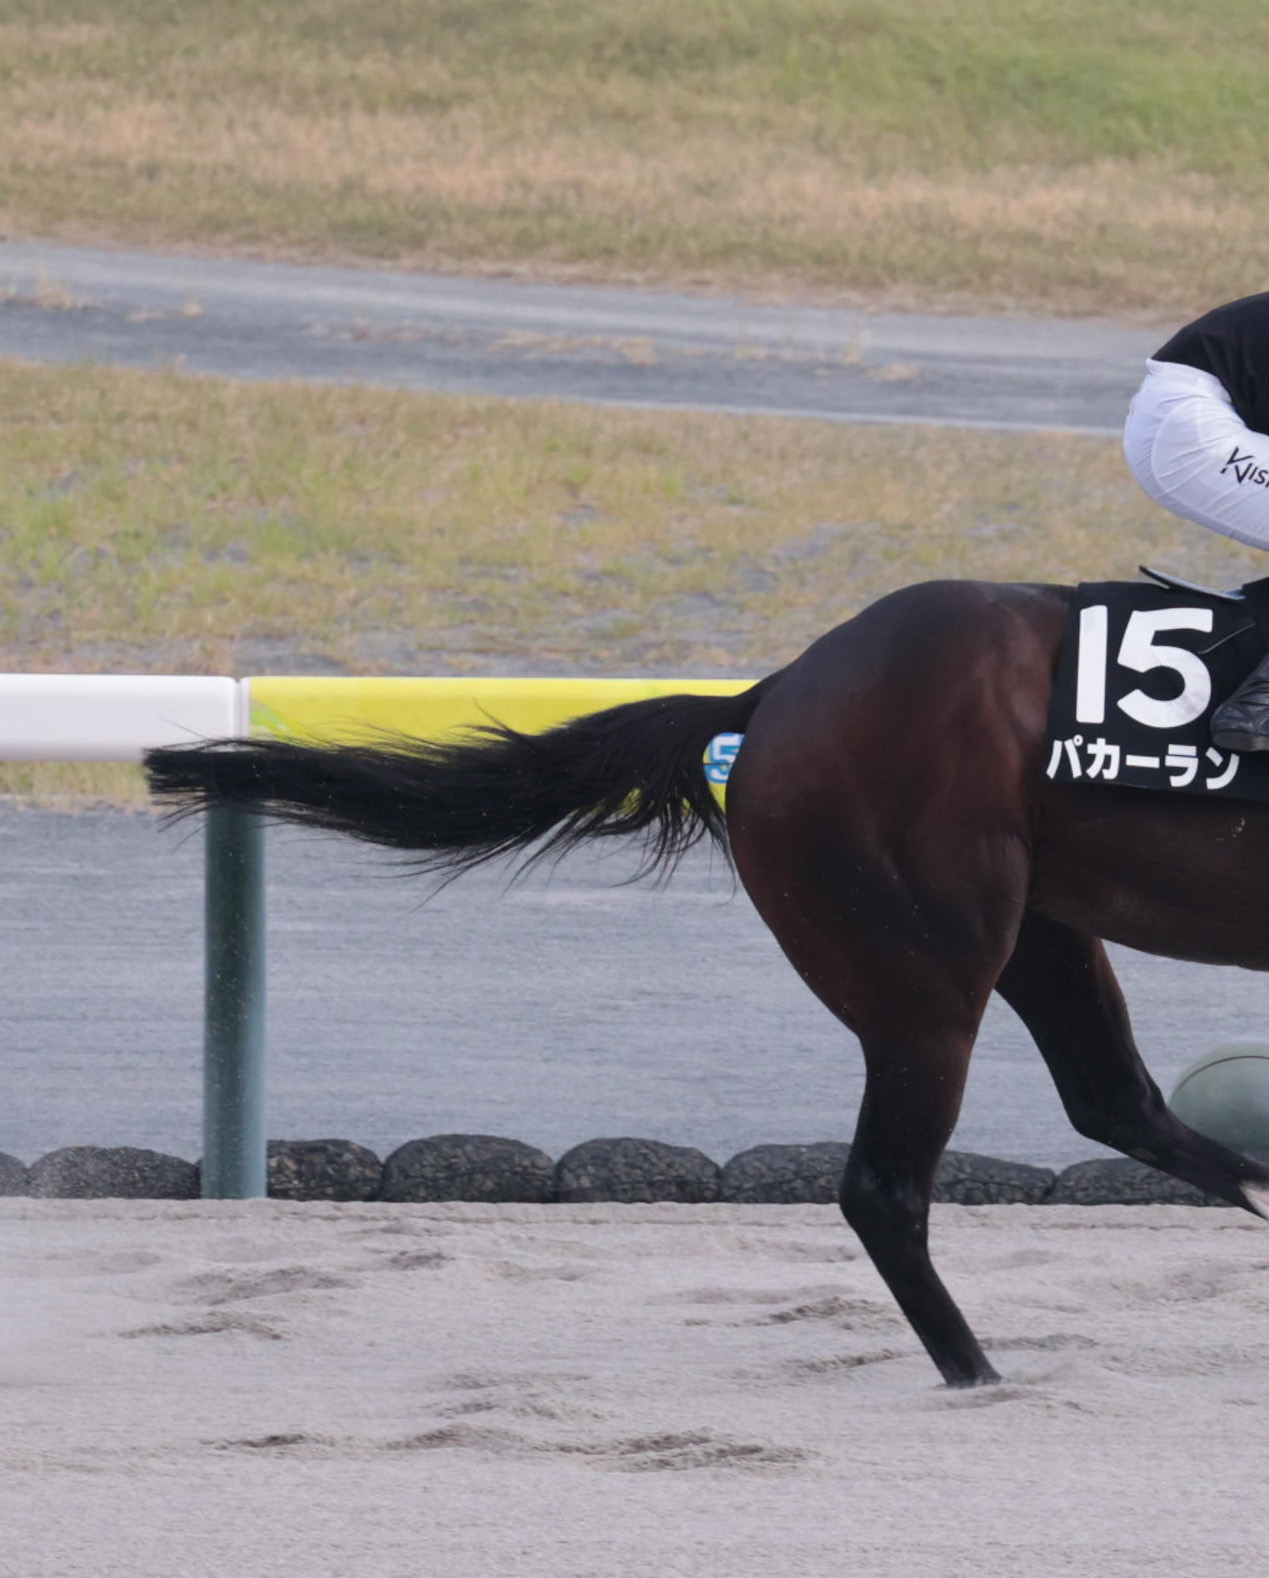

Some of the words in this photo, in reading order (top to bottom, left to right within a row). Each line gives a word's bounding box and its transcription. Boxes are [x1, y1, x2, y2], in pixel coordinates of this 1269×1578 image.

[1076, 604, 1213, 728] 15
[1046, 734, 1240, 790] パカーラン
